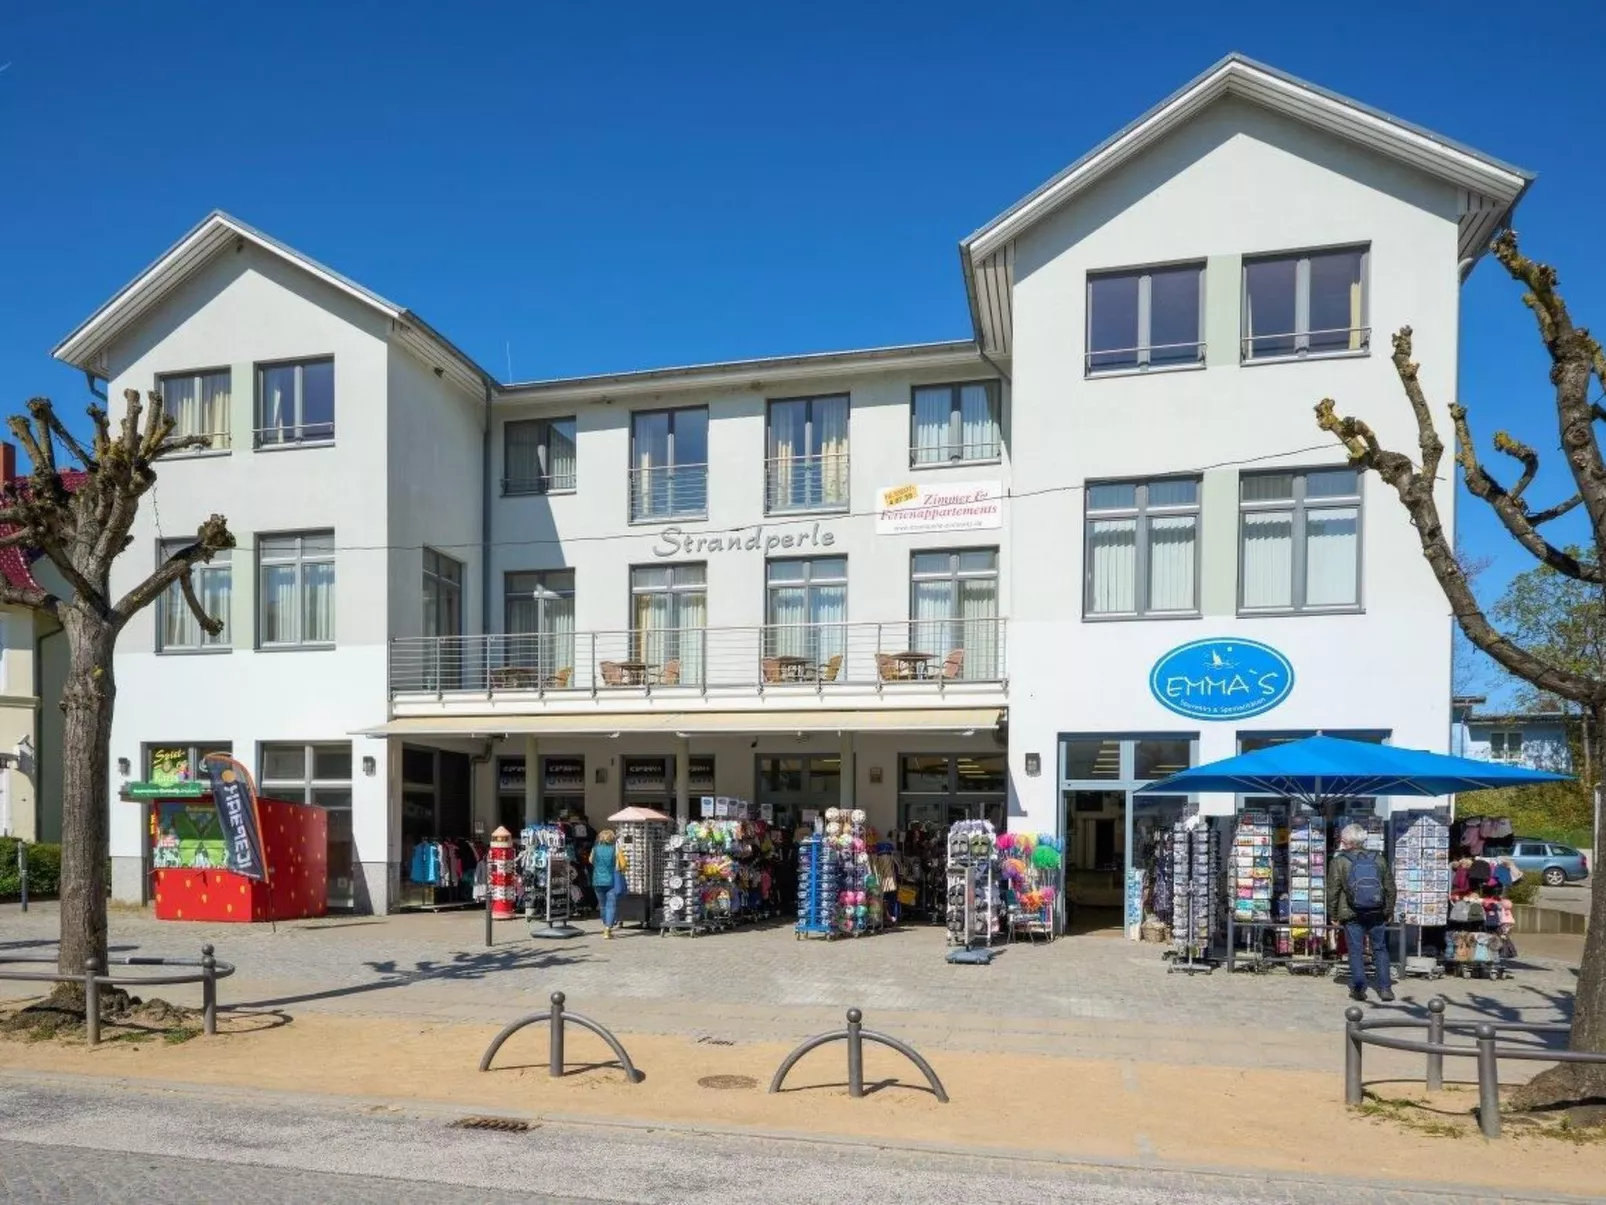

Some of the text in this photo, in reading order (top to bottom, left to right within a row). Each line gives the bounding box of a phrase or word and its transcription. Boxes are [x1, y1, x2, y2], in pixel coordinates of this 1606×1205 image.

[923, 492, 971, 507] Zimmer
[880, 503, 998, 521] Ferienappartements
[652, 523, 836, 559] Strandperle
